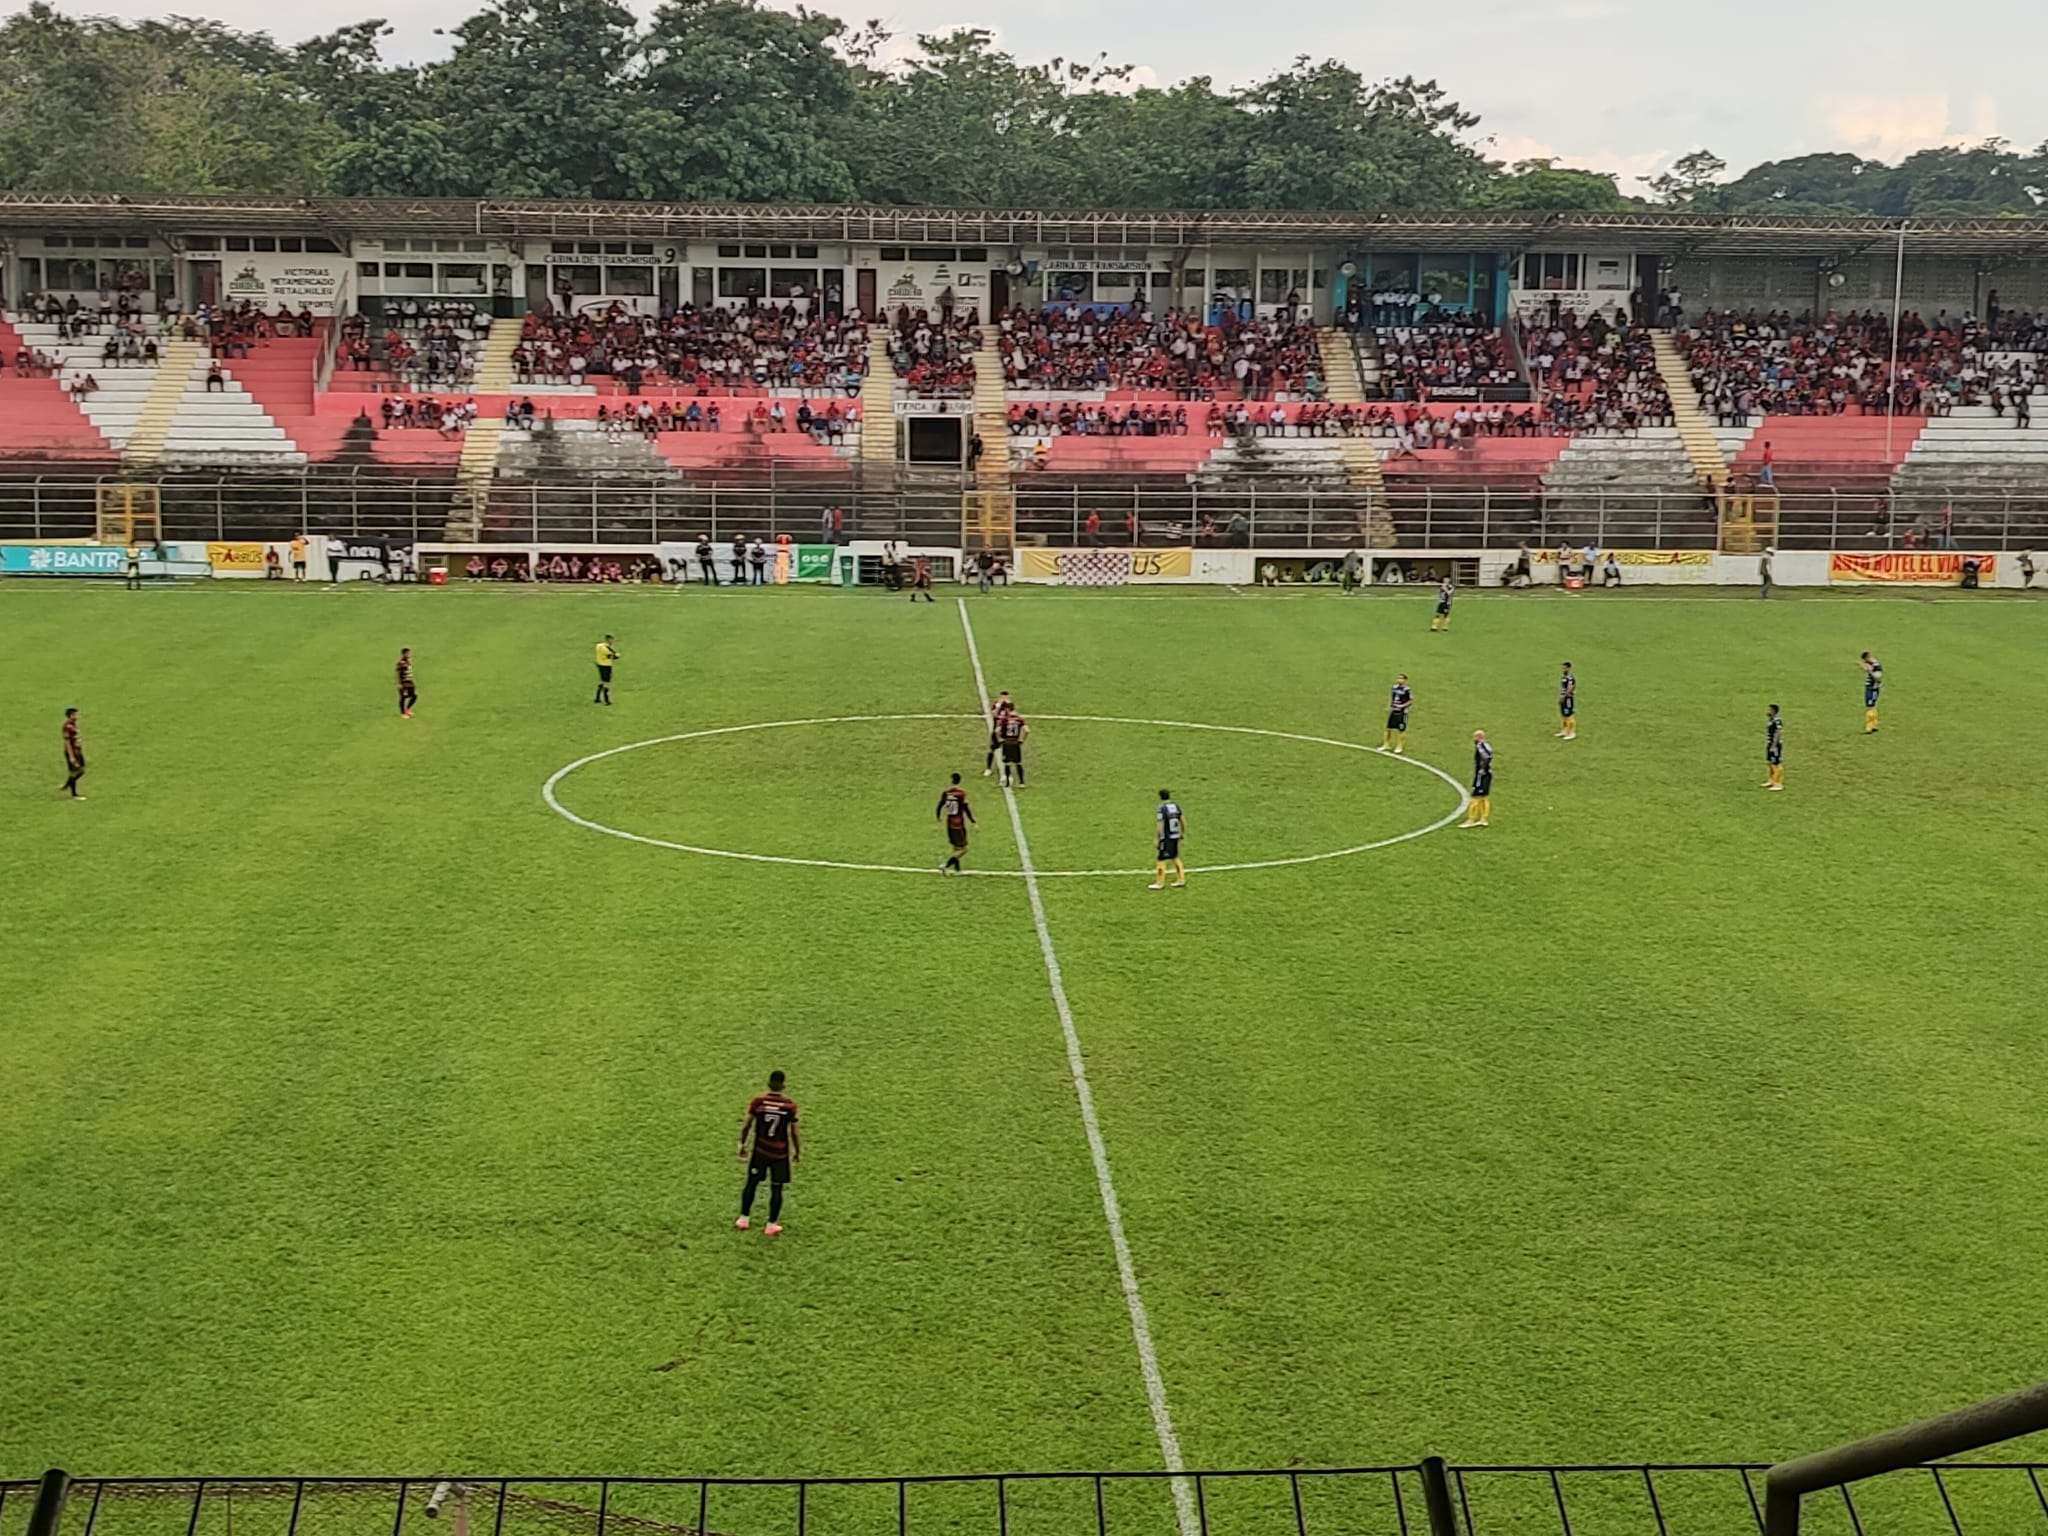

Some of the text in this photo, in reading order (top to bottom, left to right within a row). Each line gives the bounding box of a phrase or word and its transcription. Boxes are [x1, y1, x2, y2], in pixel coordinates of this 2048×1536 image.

[582, 255, 597, 264] DE
[664, 248, 676, 264] 9
[1875, 556, 1915, 572] HOTEL
[1920, 557, 1934, 573] EL
[764, 1114, 780, 1137] 7
